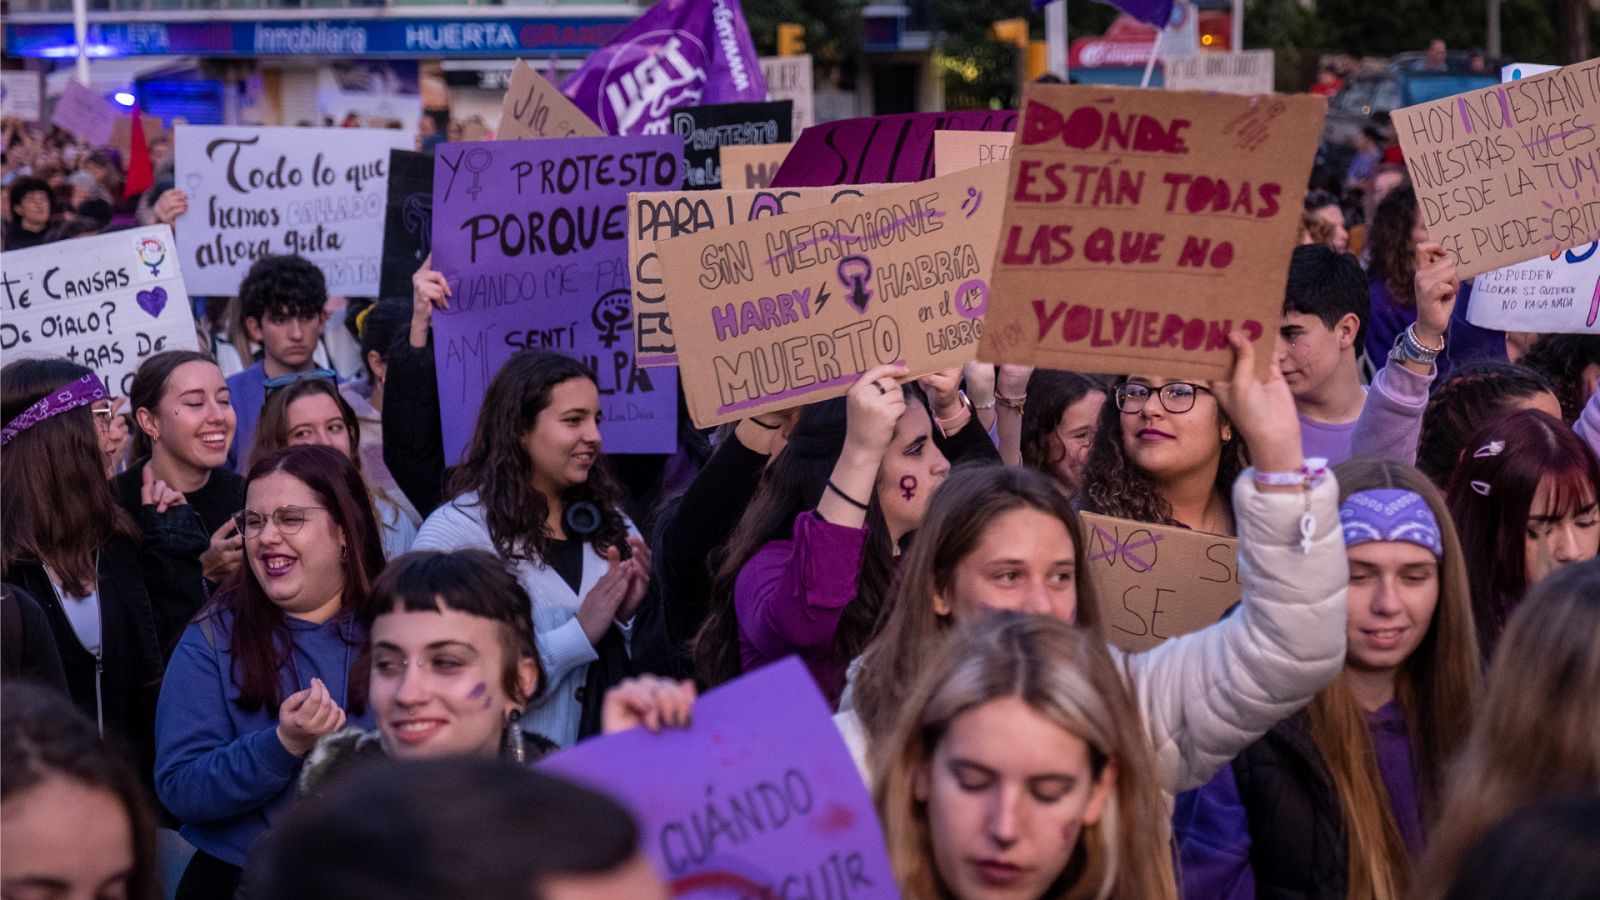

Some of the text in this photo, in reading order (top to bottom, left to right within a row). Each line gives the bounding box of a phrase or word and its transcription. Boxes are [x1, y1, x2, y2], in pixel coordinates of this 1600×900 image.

[254, 22, 367, 52] Inmobiliaria
[405, 24, 518, 49] HUERTA
[606, 37, 706, 136] UGT
[1407, 101, 1455, 145] HOY
[1464, 89, 1505, 132] NO
[1505, 66, 1586, 124] ESTÁN
[674, 112, 779, 150] PROTESTO
[1020, 96, 1192, 154] DÓNDE
[206, 135, 386, 193] Todo lo que
[510, 150, 677, 195] PROTESTO
[1409, 114, 1597, 189] NUESTRAS VOCES
[208, 192, 382, 229] hemos CALLADO
[1013, 158, 1283, 219] ESTÁN TODAS
[1421, 151, 1600, 227] DESDE LA TUM
[460, 203, 628, 264] PORQUE
[638, 197, 715, 242] PARA
[1471, 216, 1542, 257] PUEDE
[195, 223, 346, 269] ahora grita
[1001, 224, 1235, 269] LAS QUE NO
[545, 264, 580, 299] ME
[596, 257, 631, 293] PA
[712, 243, 981, 341] HARRY HABRÍA
[1478, 281, 1577, 296] LLORAR SI QUIEREN
[918, 303, 934, 323] en
[934, 290, 952, 317] el
[1502, 297, 1574, 312] NO PASA NADA
[504, 321, 579, 351] SENTÍ
[713, 314, 902, 407] MUERTO
[1088, 524, 1158, 573] NO
[1111, 584, 1177, 640] SE
[660, 768, 814, 876] CUÁNDO
